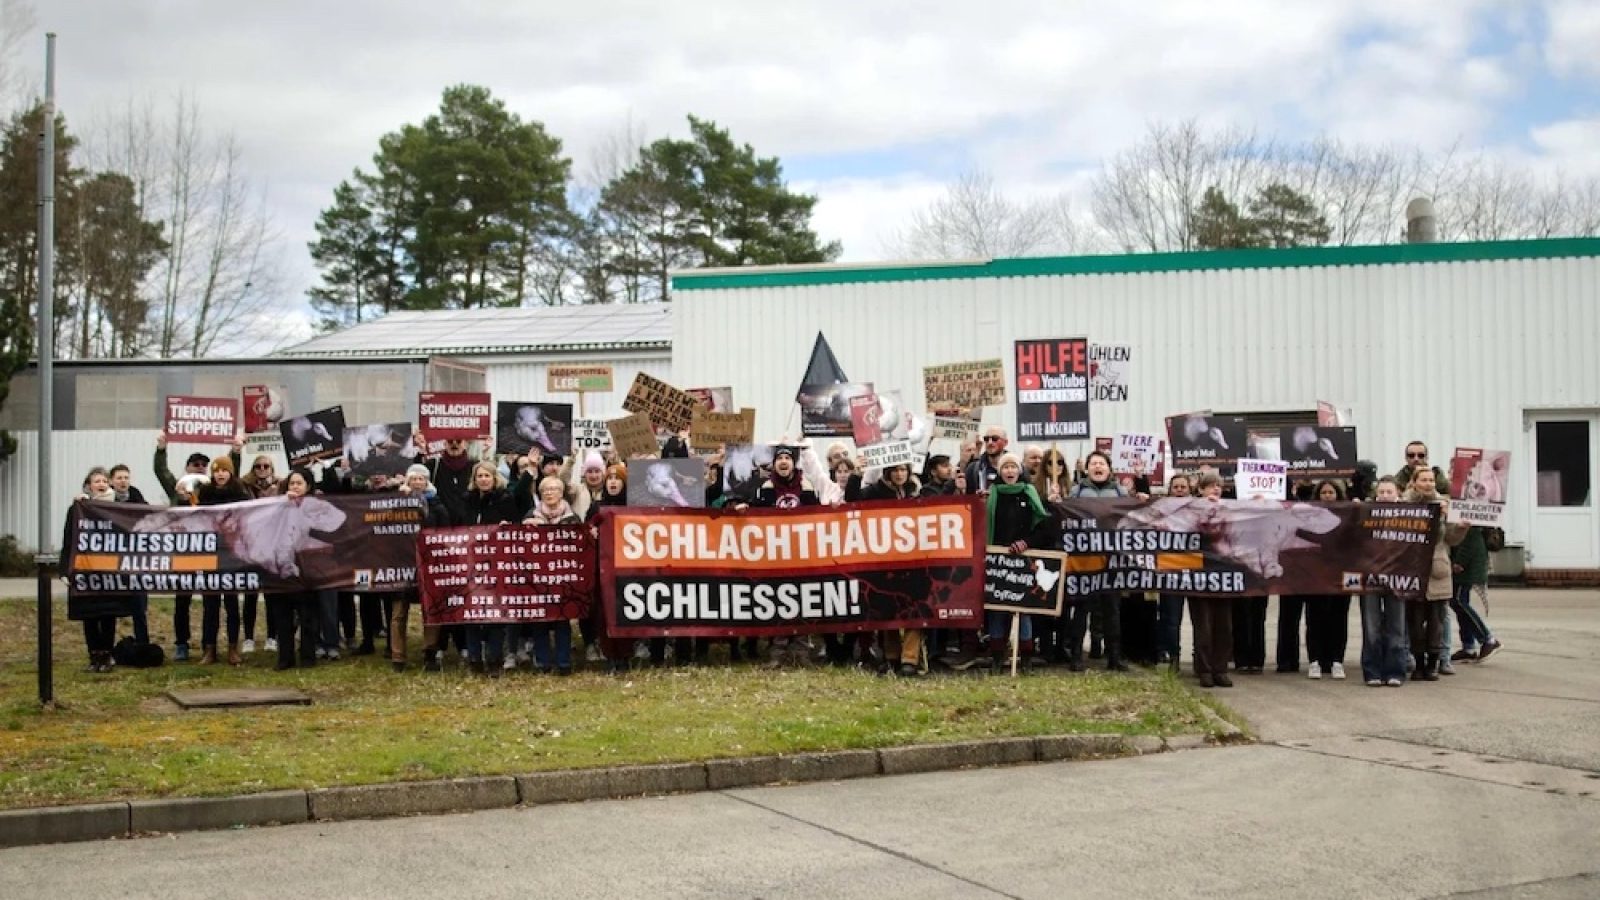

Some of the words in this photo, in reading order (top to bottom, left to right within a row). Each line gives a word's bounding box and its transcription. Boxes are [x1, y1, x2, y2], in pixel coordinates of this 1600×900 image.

[1018, 342, 1086, 373] HILFE
[1089, 343, 1131, 361] ÜHLEN
[925, 376, 938, 384] AN
[942, 373, 973, 382] JEDEM
[978, 370, 998, 380] ORT
[1041, 374, 1086, 388] YouTube
[170, 404, 234, 420] TIERQUAL
[420, 403, 488, 416] SCHLACHTEN
[168, 420, 233, 436] STOPPEN!
[429, 416, 480, 428] BEENDEN!
[1020, 422, 1042, 436] BITTE
[1045, 422, 1086, 435] ANSCHAUEN
[248, 435, 282, 444] TIERRECH
[576, 438, 600, 448] TOD
[1120, 434, 1152, 446] TIERE
[888, 443, 908, 453] TIER
[1200, 449, 1216, 458] Mal
[1310, 459, 1326, 468] Mal
[1371, 508, 1434, 518] HINSEHEN.
[1452, 502, 1502, 514] SCHLACHTEN
[1062, 518, 1079, 529] FÜR
[1082, 518, 1097, 528] DIE
[78, 532, 217, 552] SCHLIESSUNG
[426, 533, 470, 544] Solange
[475, 533, 489, 542] es
[497, 531, 540, 542] Käfige
[547, 530, 584, 540] gibt,
[623, 511, 965, 562] SCHLACHTHÄUSER
[1063, 531, 1201, 552] SCHLIESSUNG
[1372, 530, 1430, 544] HANDELN.
[432, 546, 468, 556] werden
[474, 546, 496, 554] wir
[504, 545, 526, 554] sie
[532, 544, 583, 554] öffnen.
[120, 555, 170, 572] ALLER
[428, 563, 468, 574] Solange
[475, 563, 490, 571] es
[496, 560, 541, 570] Ketten
[548, 560, 584, 571] gibt,
[1108, 554, 1156, 570] ALLER
[76, 570, 260, 591] SCHLACHTHÄUSER
[376, 567, 416, 582] ARIW
[434, 576, 468, 586] werden
[474, 575, 496, 584] wir
[504, 575, 526, 584] sie
[533, 574, 584, 585] kappen.
[1066, 569, 1245, 595] SCHLACHTHÄUSER
[1367, 574, 1420, 590] ARIWA
[448, 595, 464, 606] FÜR
[472, 596, 494, 605] DIE
[502, 594, 561, 605] FREIHEIT
[623, 580, 862, 621] SCHLIESSEN!
[464, 608, 501, 618] ALLER
[508, 608, 546, 618] TIERE
